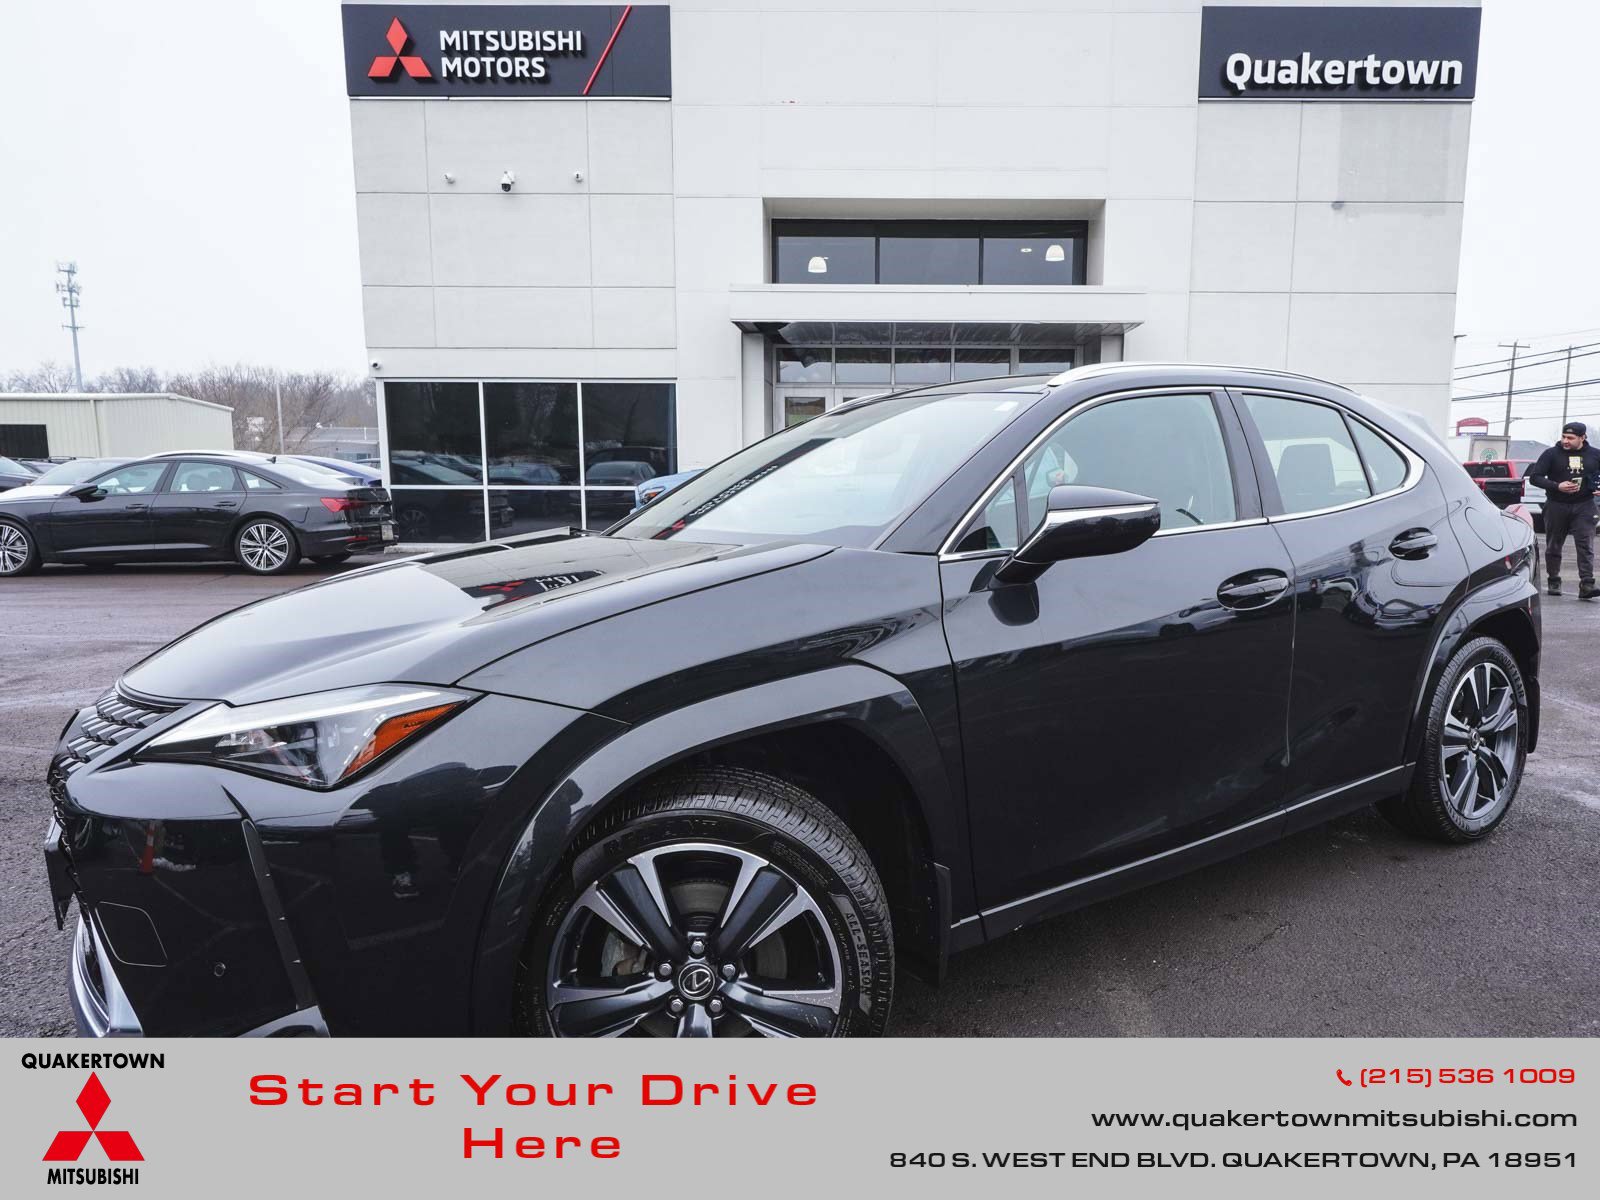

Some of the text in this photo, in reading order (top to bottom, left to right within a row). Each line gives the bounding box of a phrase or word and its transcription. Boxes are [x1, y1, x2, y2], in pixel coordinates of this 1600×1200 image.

[439, 30, 582, 51] MITSUBISHI
[441, 57, 546, 78] MOTORS
[1226, 52, 1463, 90] Quakertown
